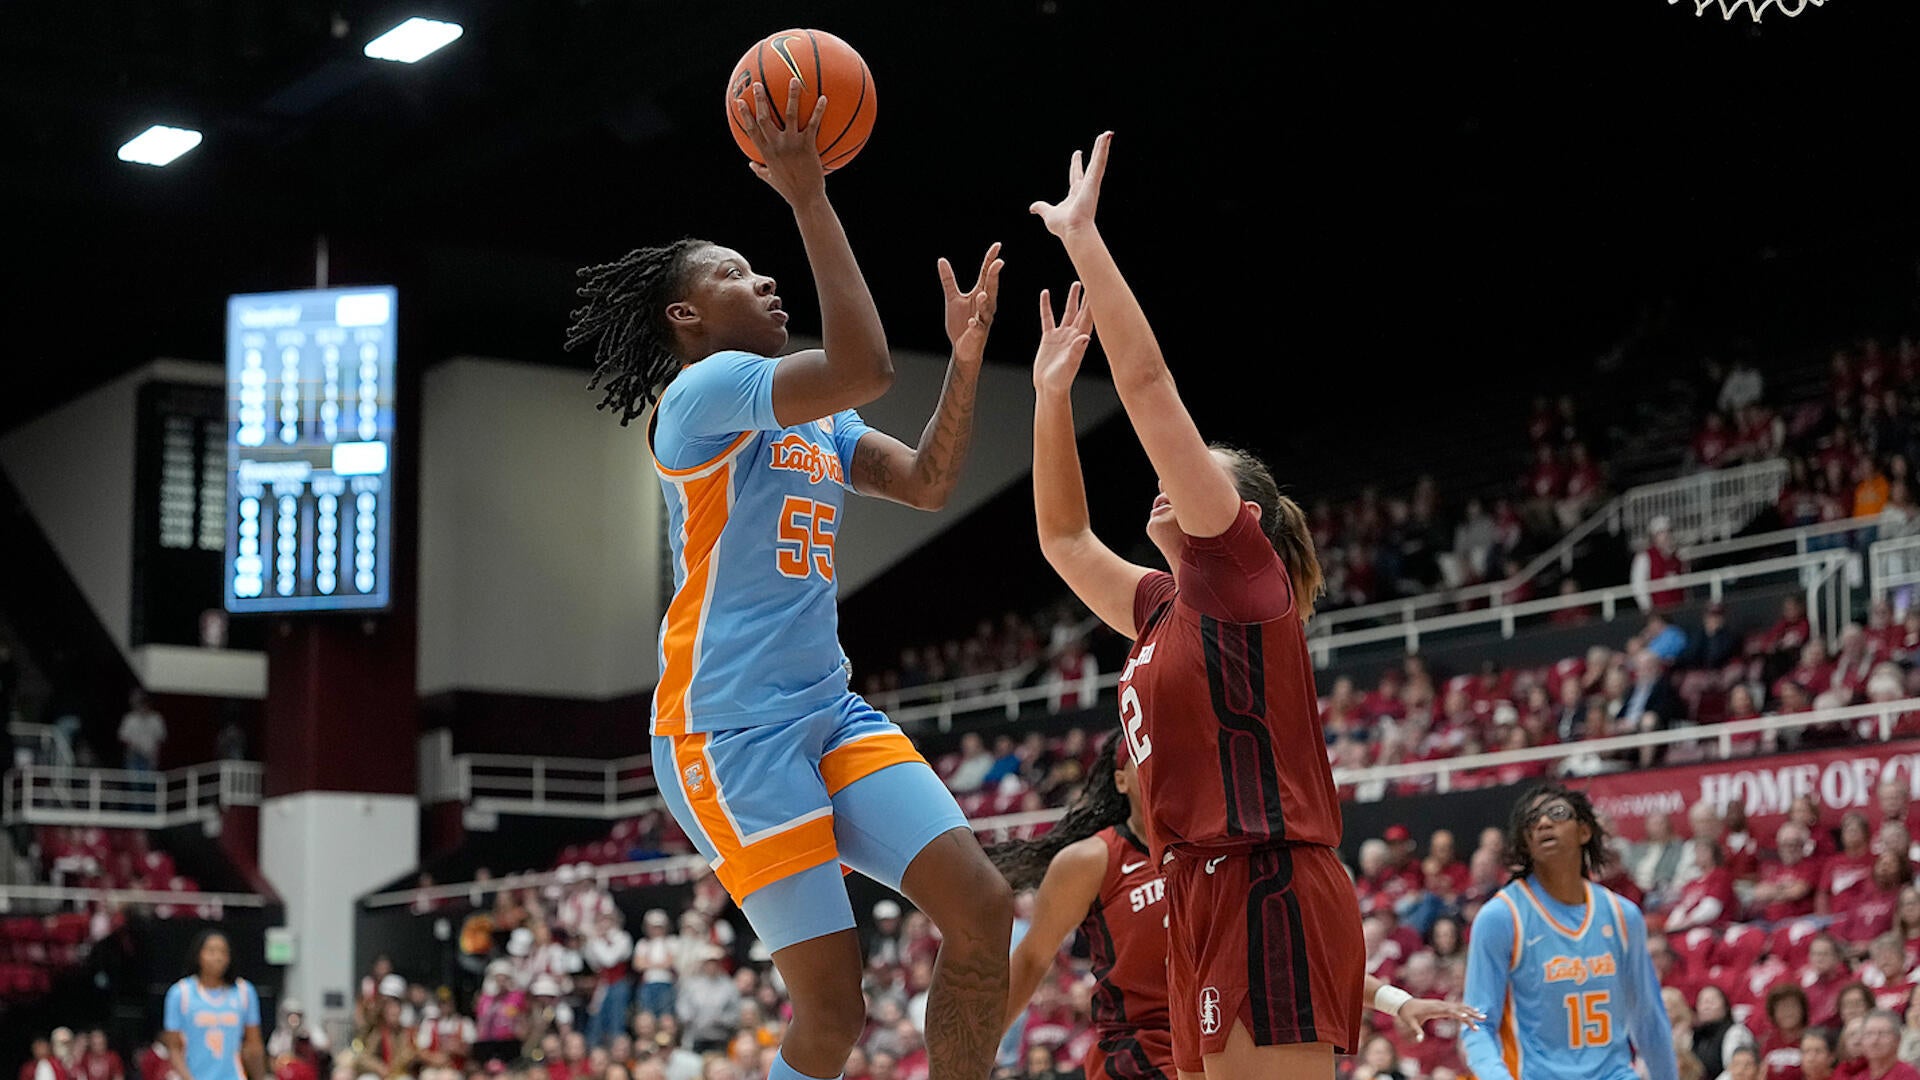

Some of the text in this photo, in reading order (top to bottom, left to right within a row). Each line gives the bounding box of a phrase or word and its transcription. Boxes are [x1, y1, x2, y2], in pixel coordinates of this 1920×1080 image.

[769, 433, 826, 484] Lady
[776, 495, 835, 583] 55
[1119, 685, 1152, 767] 2
[1701, 763, 1820, 819] HOME
[1821, 758, 1880, 810] OF
[1129, 877, 1167, 912] STA
[1564, 990, 1612, 1049] 15
